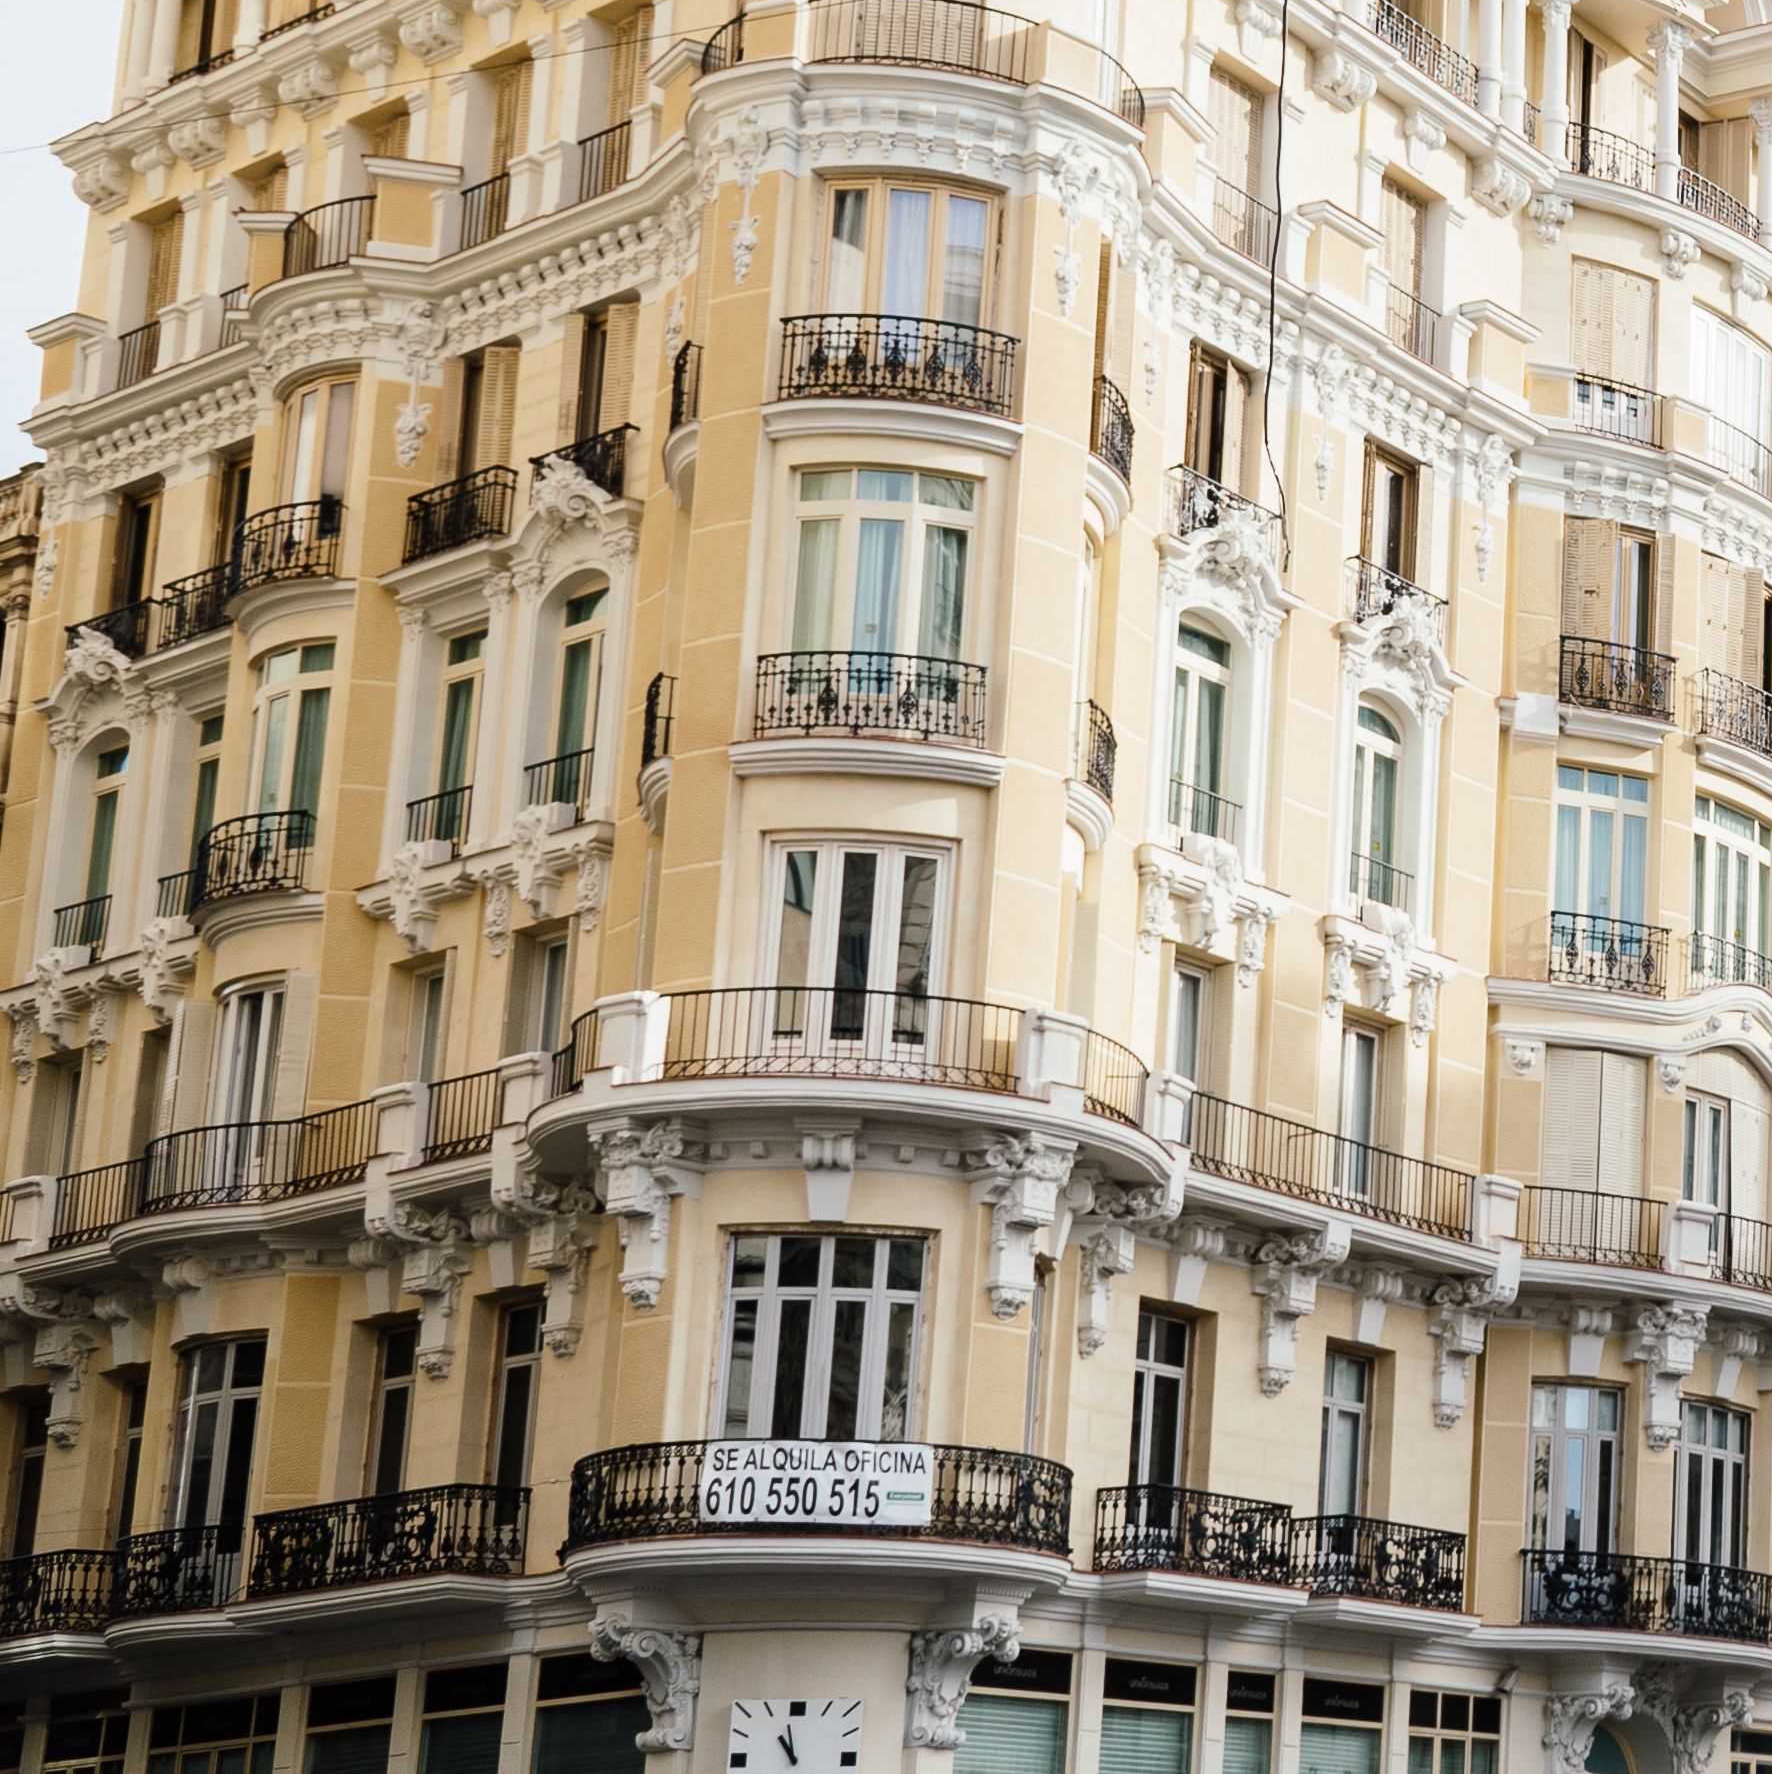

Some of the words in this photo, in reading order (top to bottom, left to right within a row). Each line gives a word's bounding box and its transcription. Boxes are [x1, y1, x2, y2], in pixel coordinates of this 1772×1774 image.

[712, 1448, 740, 1471] SE
[743, 1447, 837, 1473] ALQUILA
[844, 1449, 927, 1474] OFICINA
[705, 1477, 756, 1515] 610
[765, 1477, 817, 1516] 550
[828, 1478, 880, 1518] 515
